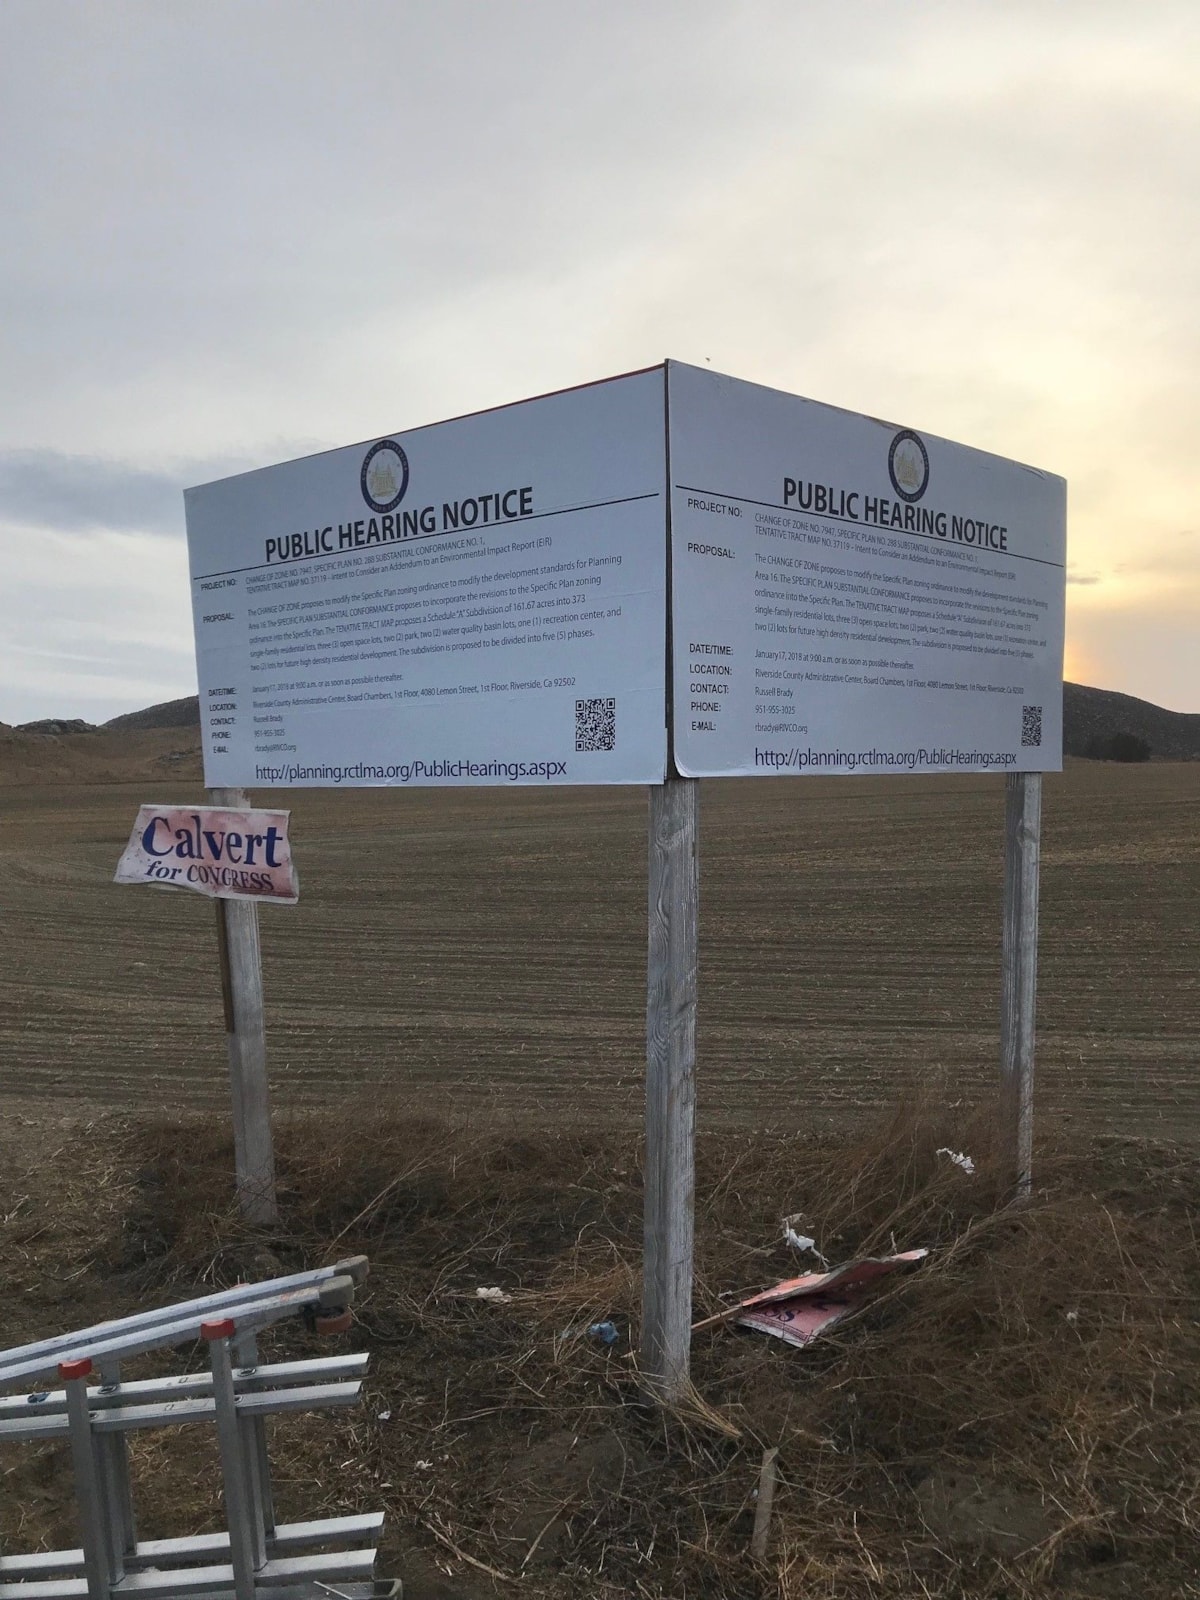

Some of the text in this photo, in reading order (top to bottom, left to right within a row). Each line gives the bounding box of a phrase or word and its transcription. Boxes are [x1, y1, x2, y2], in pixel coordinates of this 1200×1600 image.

[688, 498, 742, 518] PROJECT NO:
[783, 476, 1007, 550] PUBLIC HEARING NOTICE
[265, 485, 533, 562] PUBLIC HEARING NOTICE
[755, 512, 781, 526] CHANGE
[783, 518, 791, 528] OF
[792, 520, 808, 531] ZONE
[838, 528, 860, 541] SPECIFIC
[755, 525, 849, 550] TENTATIVE TRACT MAP 37119
[356, 567, 380, 576] Consider
[390, 560, 422, 571] Addendum
[440, 548, 486, 563] Environmental
[487, 544, 510, 555] Impact
[512, 540, 535, 551] Report
[536, 537, 552, 548] (EIR)
[376, 549, 414, 562] SUBSTANTIAL
[417, 540, 464, 555] CONFORMANCE
[688, 542, 736, 559] PROPOSAL:
[755, 553, 766, 563] The
[767, 555, 793, 567] CHANGE
[795, 559, 802, 568] OF
[804, 561, 819, 571] ZONE
[398, 586, 417, 594] zoning
[418, 582, 449, 591] ordinance
[458, 576, 480, 586] modify
[482, 574, 492, 582] the
[494, 567, 539, 580] development
[540, 562, 575, 574] standards
[576, 561, 587, 569] for
[589, 555, 622, 567] Planning
[755, 570, 768, 580] Area
[781, 574, 791, 583] The
[792, 576, 816, 587] SPECIFIC
[818, 580, 833, 589] PLAN
[201, 580, 226, 591] PROJECT
[395, 602, 422, 613] proposes
[423, 599, 429, 607] to
[431, 594, 466, 606] incorporate
[467, 592, 478, 601] the
[479, 589, 507, 599] revisions
[509, 587, 517, 595] to
[518, 585, 529, 594] the
[530, 581, 557, 594] Specific
[559, 580, 574, 589] Plan
[576, 576, 601, 586] zoning
[755, 588, 830, 605] ordinance into the Specific
[395, 618, 421, 627] proposes
[466, 606, 503, 617] Subdivision
[505, 604, 512, 612] of
[513, 601, 535, 611] 161.67
[537, 600, 555, 608] acres
[557, 597, 570, 606] into
[572, 594, 585, 604] 373
[755, 605, 792, 619] single-family
[794, 610, 823, 620] residential
[461, 625, 482, 635] quality
[484, 622, 501, 631] basin
[503, 621, 516, 629] lots,
[533, 617, 541, 627] (1)
[543, 613, 578, 624] recreation
[580, 610, 605, 620] center,
[607, 607, 621, 617] and
[755, 622, 767, 631] two
[768, 623, 776, 633] (2)
[777, 624, 787, 633] lots
[797, 626, 815, 636] future
[816, 628, 828, 638] high
[411, 645, 444, 654] subdivision
[446, 643, 450, 651] is
[452, 640, 482, 652] proposed
[483, 639, 490, 647] to
[492, 638, 499, 646] be
[501, 635, 526, 645] divided
[528, 634, 541, 643] into
[543, 633, 556, 641] five
[557, 631, 566, 641] (5)
[568, 630, 595, 641] phases.
[689, 644, 733, 656] DATE/TIME:
[788, 652, 802, 661] 2018
[803, 653, 808, 661] at
[810, 654, 821, 662] 9:00
[690, 664, 732, 676] LOCATION:
[755, 669, 803, 682] Riverside County
[421, 688, 436, 696] 4080
[459, 685, 479, 694] Street,
[481, 684, 490, 692] 1st
[491, 683, 509, 692] Floor,
[510, 680, 542, 690] Riverside,
[544, 679, 552, 688] Ca
[554, 677, 575, 687] 92502
[690, 683, 729, 694] CONTACT:
[755, 687, 793, 698] Russell Brady
[691, 702, 721, 712] PHONE:
[755, 705, 796, 714] 951-955-3025
[692, 722, 716, 731] E-MAIL:
[755, 747, 1016, 770] http://planning.rctlma.org/PublicHearings.aspx
[255, 758, 567, 783] http://planning.rctlma.org/PublicHearings.aspx
[142, 815, 283, 867] Calvert
[145, 861, 274, 890] for CONGRESS
